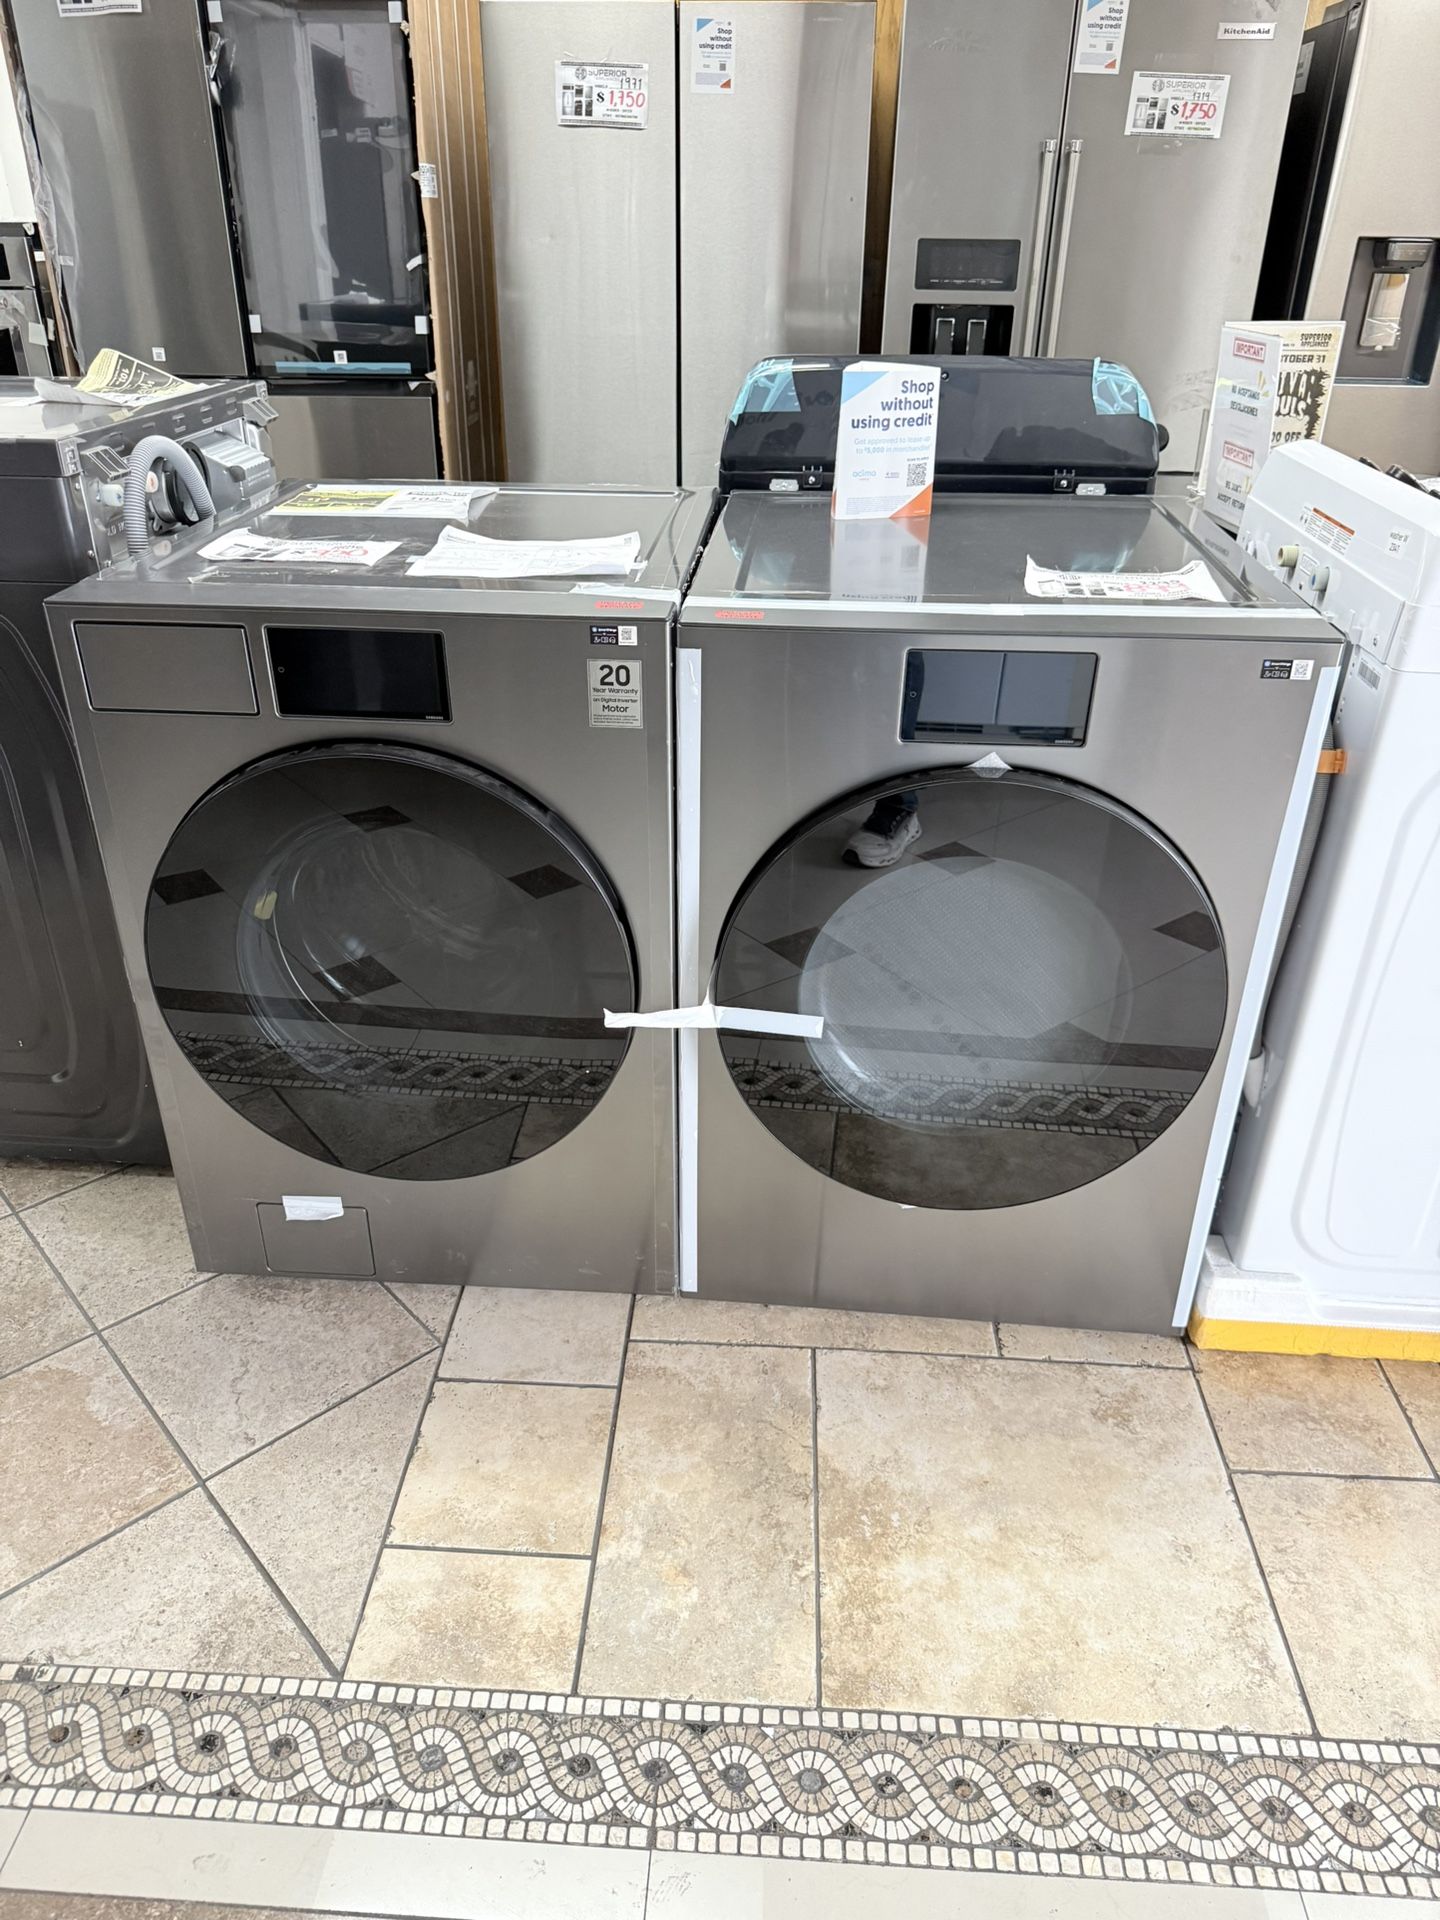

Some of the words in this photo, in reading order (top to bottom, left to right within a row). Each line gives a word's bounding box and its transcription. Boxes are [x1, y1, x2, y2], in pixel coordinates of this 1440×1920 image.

[1109, 7, 1124, 15] Shop
[1087, 22, 1104, 30] using
[717, 27, 733, 36] Shop
[1223, 27, 1271, 35] KitchenAid
[1166, 80, 1207, 90] SUPERIOR
[1300, 333, 1333, 342] SUPERIOR
[901, 379, 935, 396] Shop
[881, 397, 934, 412] without
[851, 414, 891, 432] using
[894, 413, 933, 428] credit
[1284, 431, 1302, 442] OFF
[852, 468, 877, 478] acima
[599, 664, 631, 687] 20
[608, 687, 639, 696] Warranty
[602, 704, 630, 713] Motor
